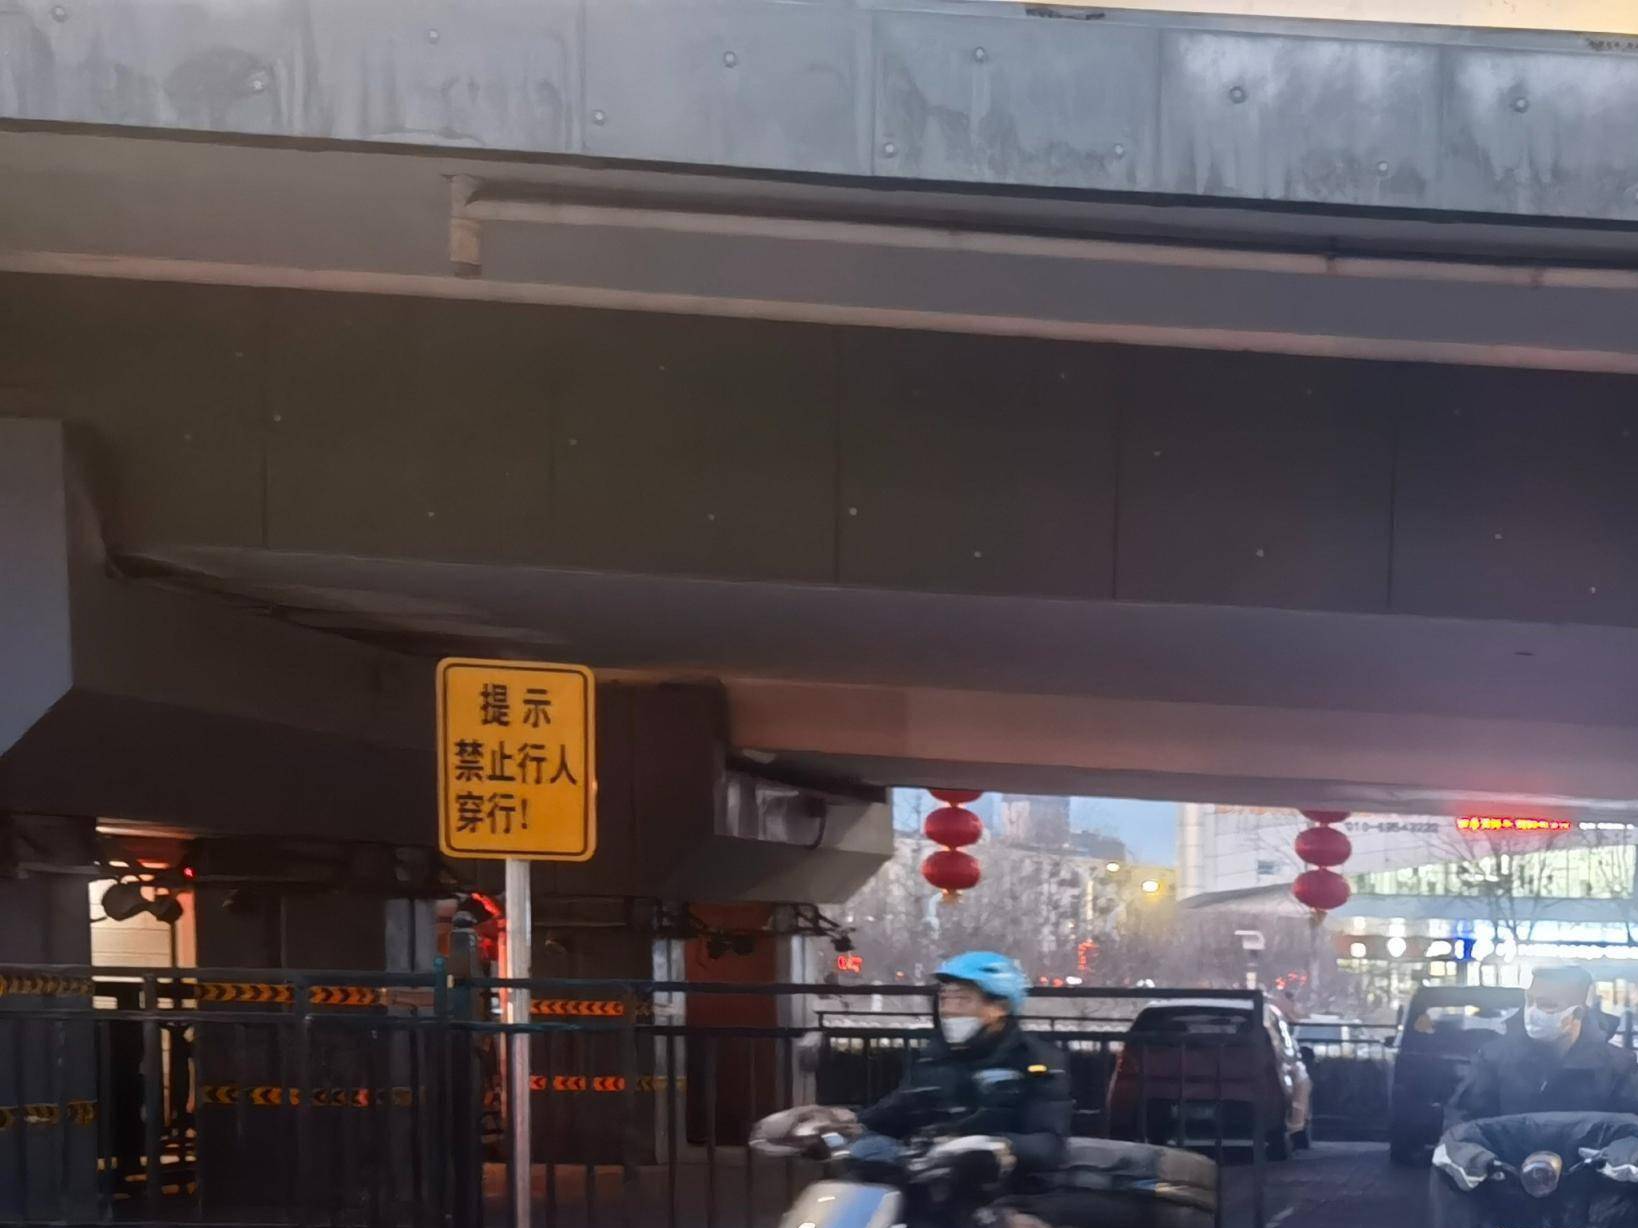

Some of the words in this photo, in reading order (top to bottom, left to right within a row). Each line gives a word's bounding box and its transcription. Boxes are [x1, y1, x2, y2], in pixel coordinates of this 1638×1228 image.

[480, 683, 552, 728] 提示
[454, 739, 577, 785] 禁止行人
[455, 791, 529, 834] 穿行!
